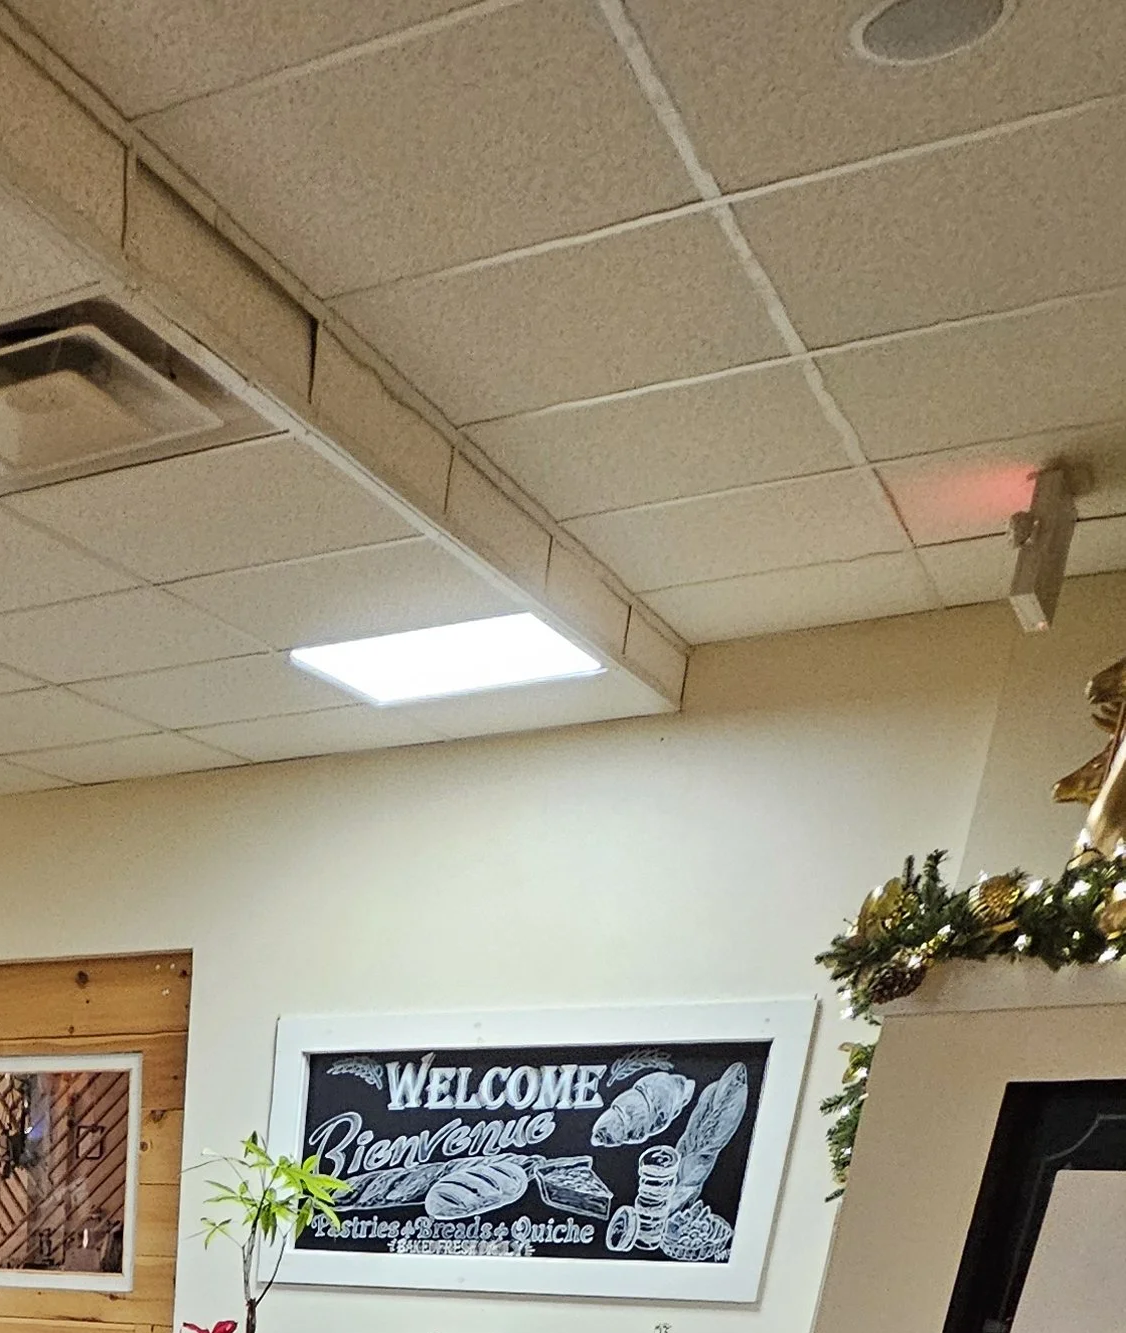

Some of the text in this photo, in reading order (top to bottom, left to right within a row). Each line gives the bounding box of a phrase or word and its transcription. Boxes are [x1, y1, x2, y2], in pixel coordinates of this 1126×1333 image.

[385, 1052, 607, 1110] WELCOME
[309, 1111, 556, 1178] Bienvenue
[311, 1213, 595, 1245] Pastries Breads Quiche
